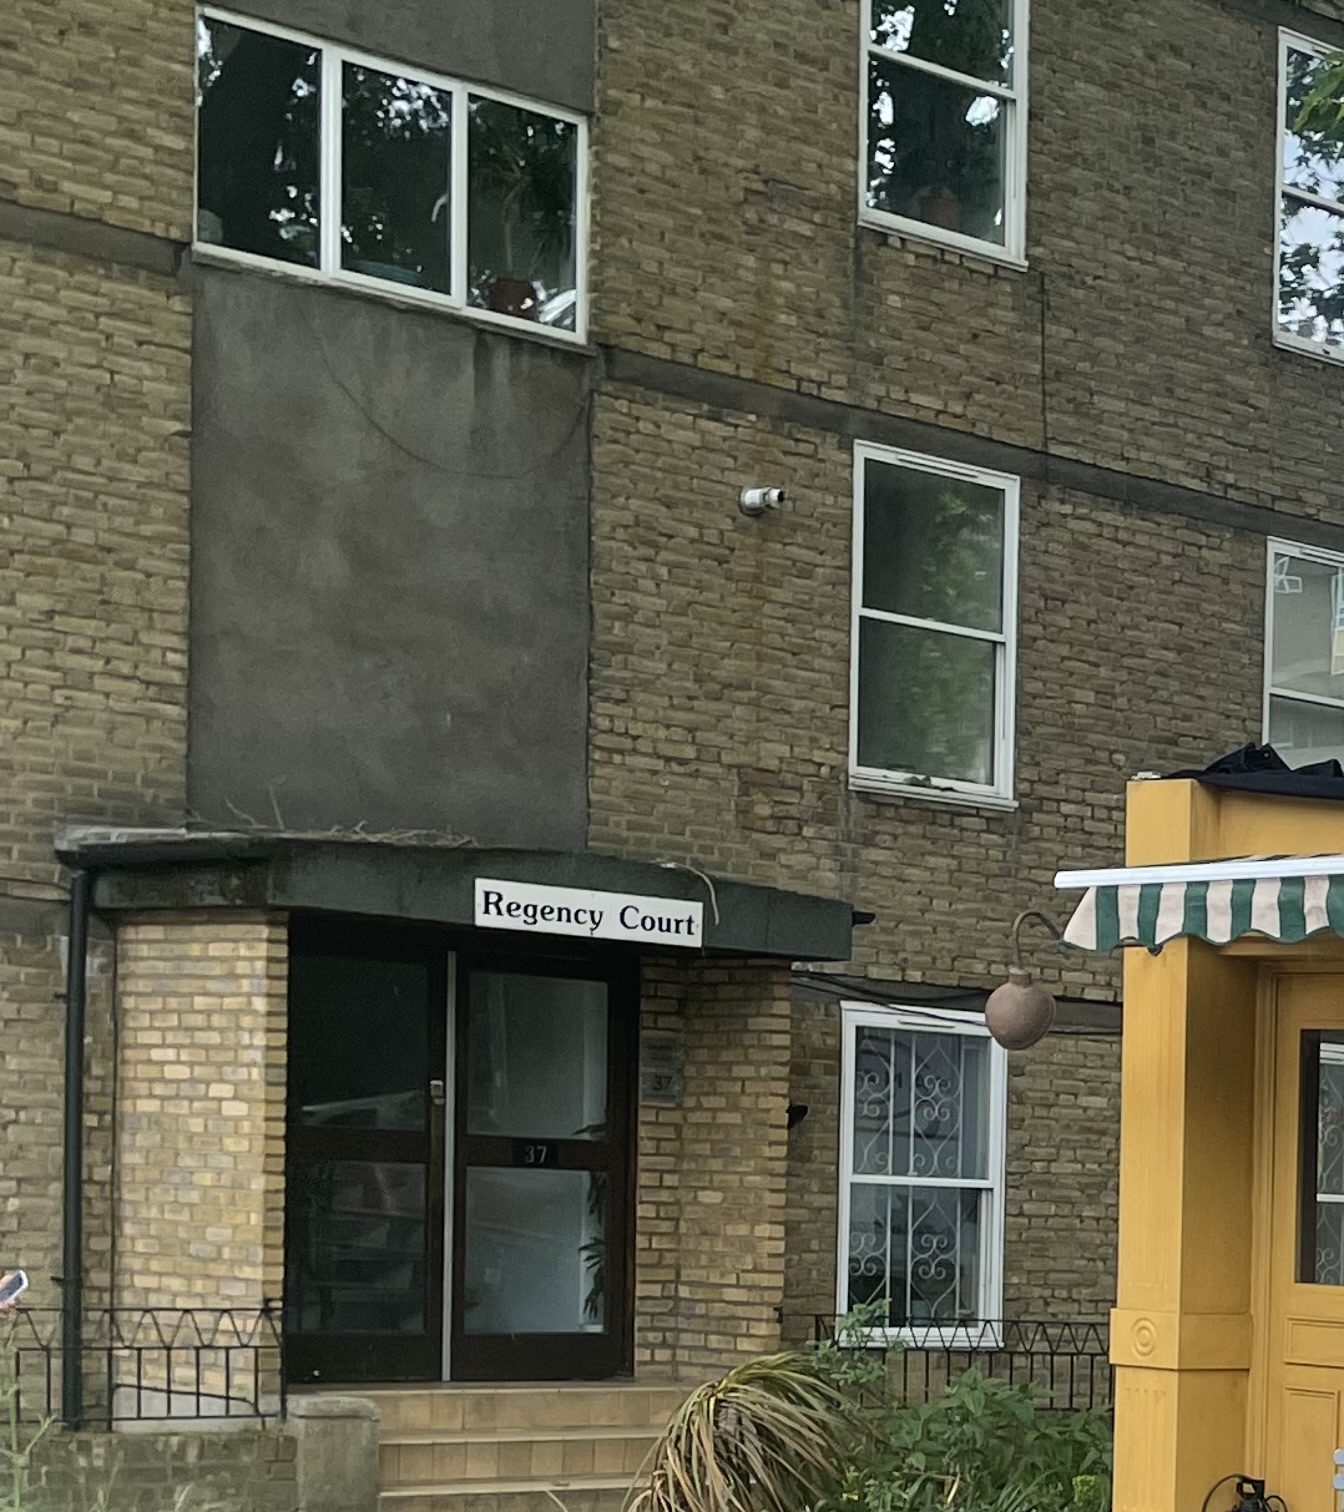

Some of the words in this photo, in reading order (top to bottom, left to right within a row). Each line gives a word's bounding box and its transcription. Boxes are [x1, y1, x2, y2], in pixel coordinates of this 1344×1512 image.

[481, 889, 604, 931] Regency
[618, 904, 696, 936] Court
[524, 1145, 547, 1164] 37
